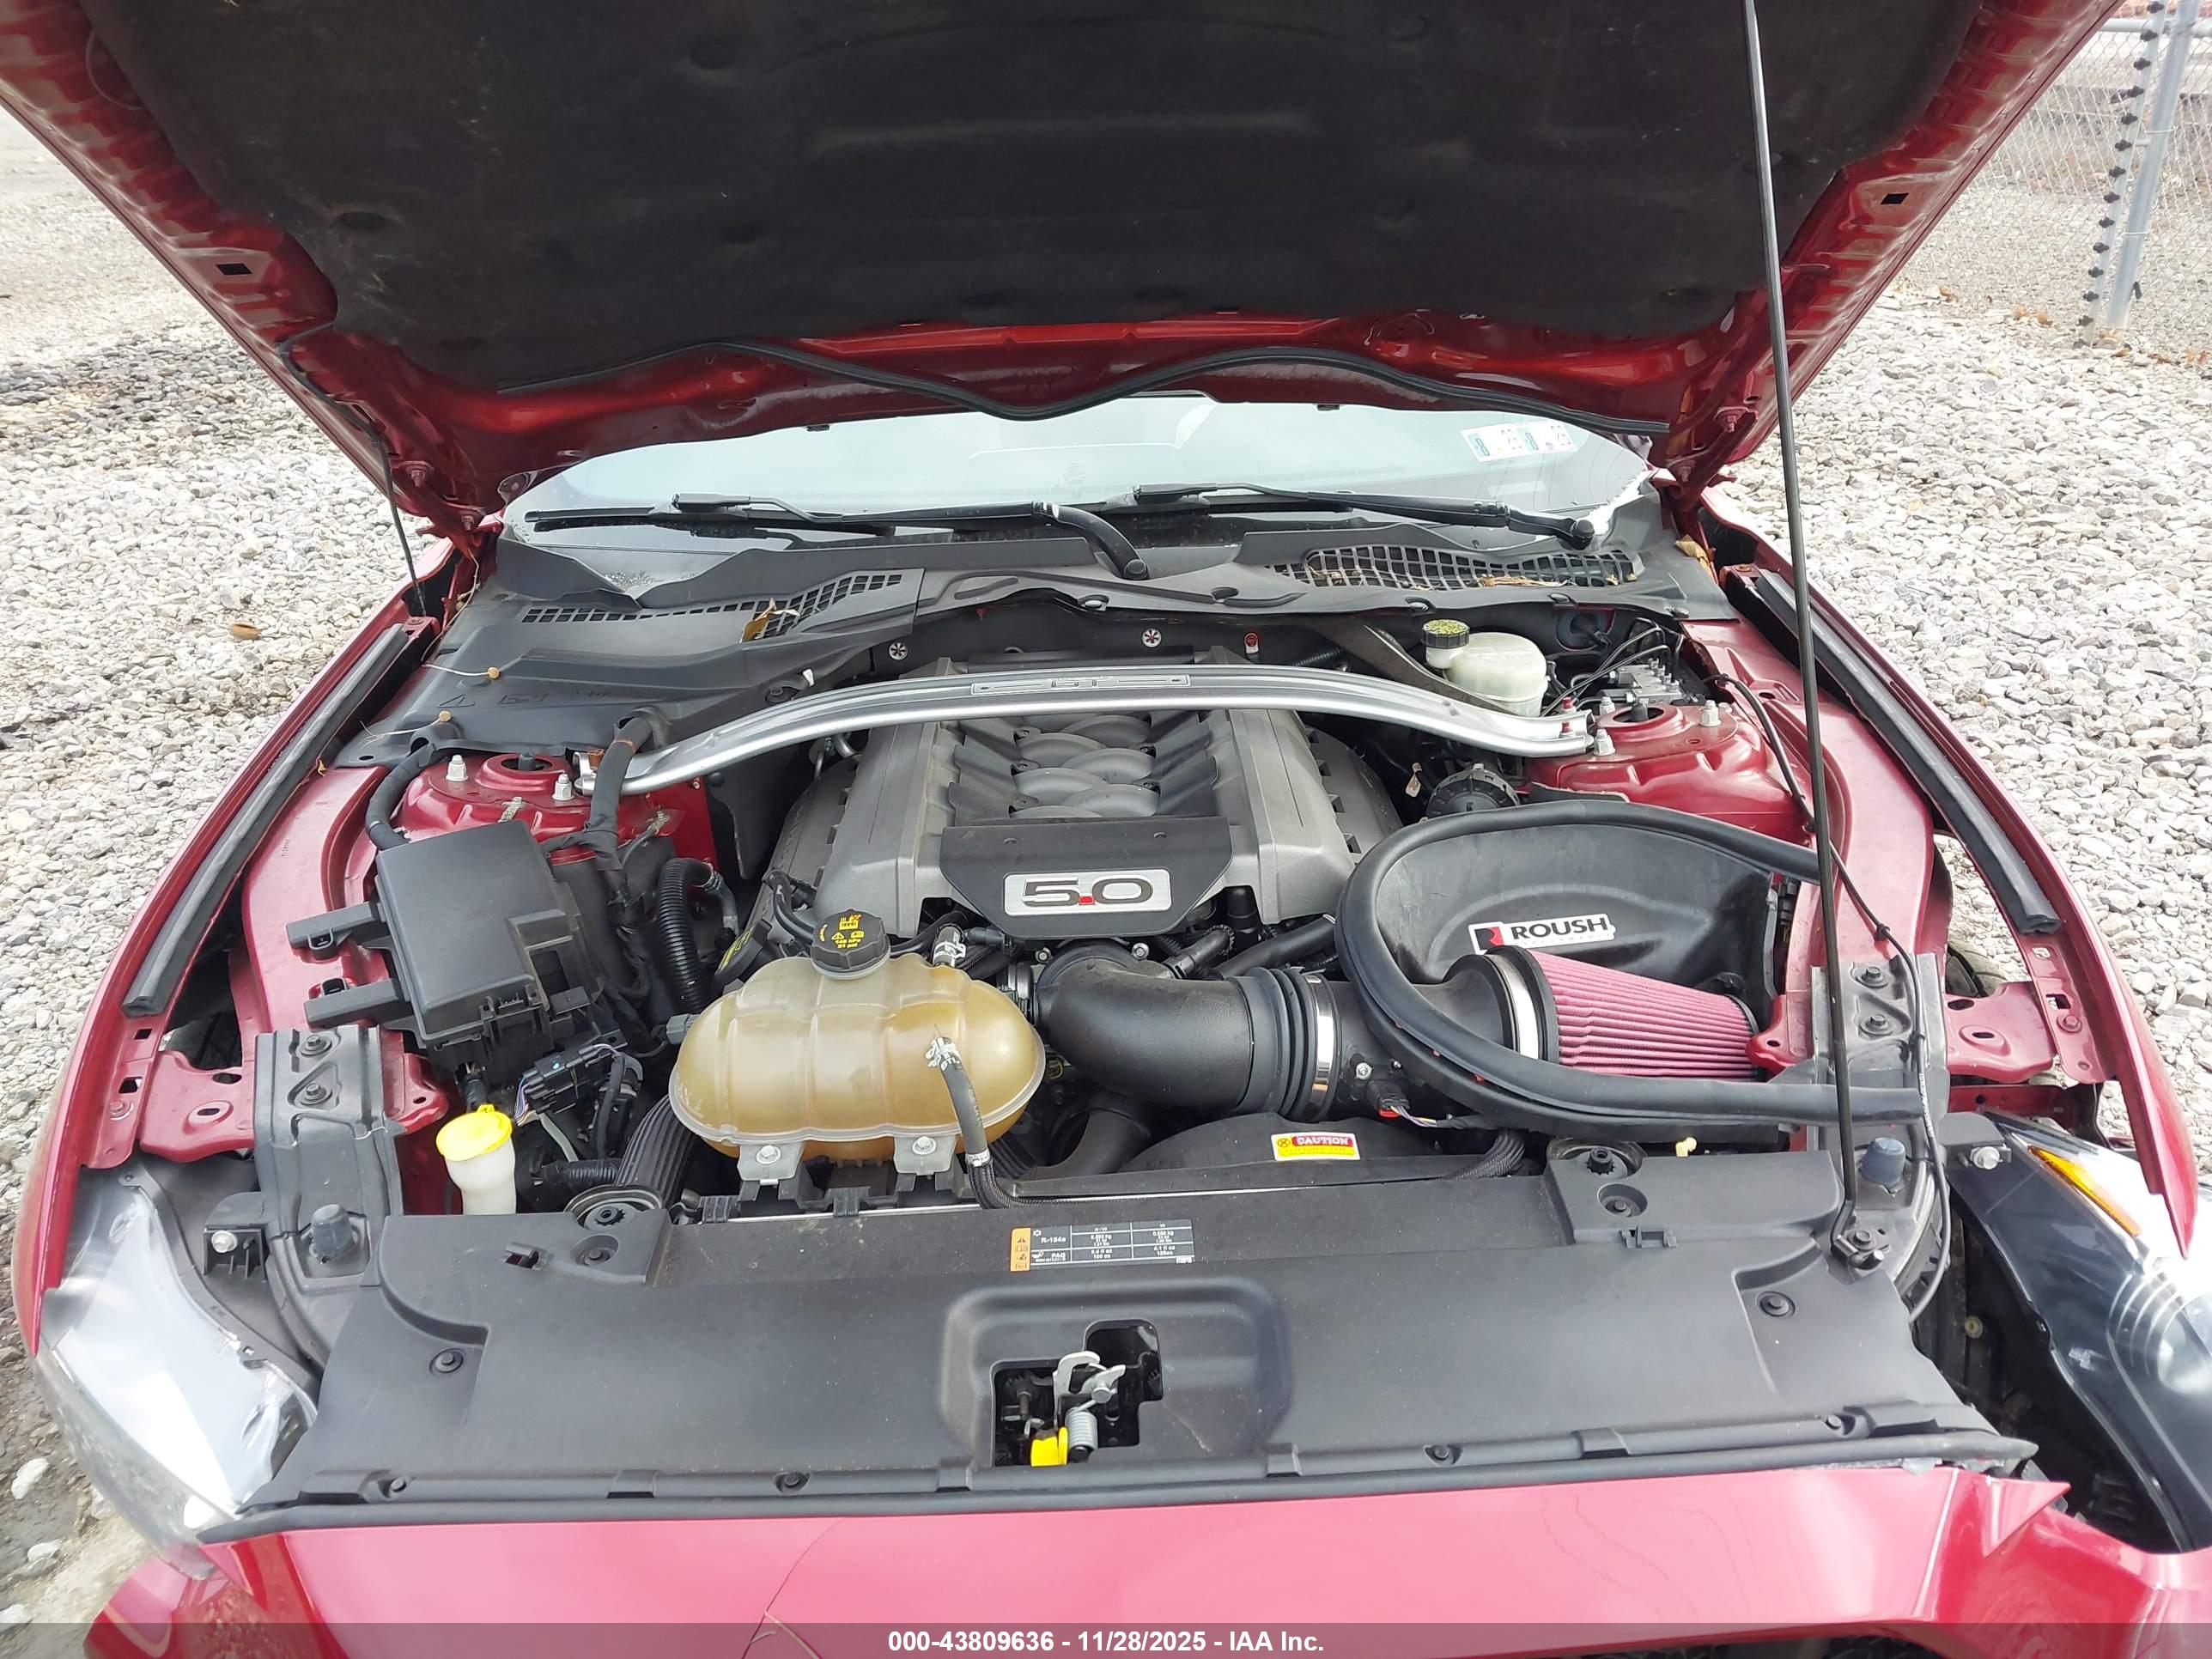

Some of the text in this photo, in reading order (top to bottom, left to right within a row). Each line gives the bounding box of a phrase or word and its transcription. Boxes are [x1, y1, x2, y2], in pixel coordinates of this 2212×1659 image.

[1022, 877, 1154, 908] 5.0
[1510, 917, 1608, 940] ROUSH
[1297, 1136, 1348, 1146] CAUTION
